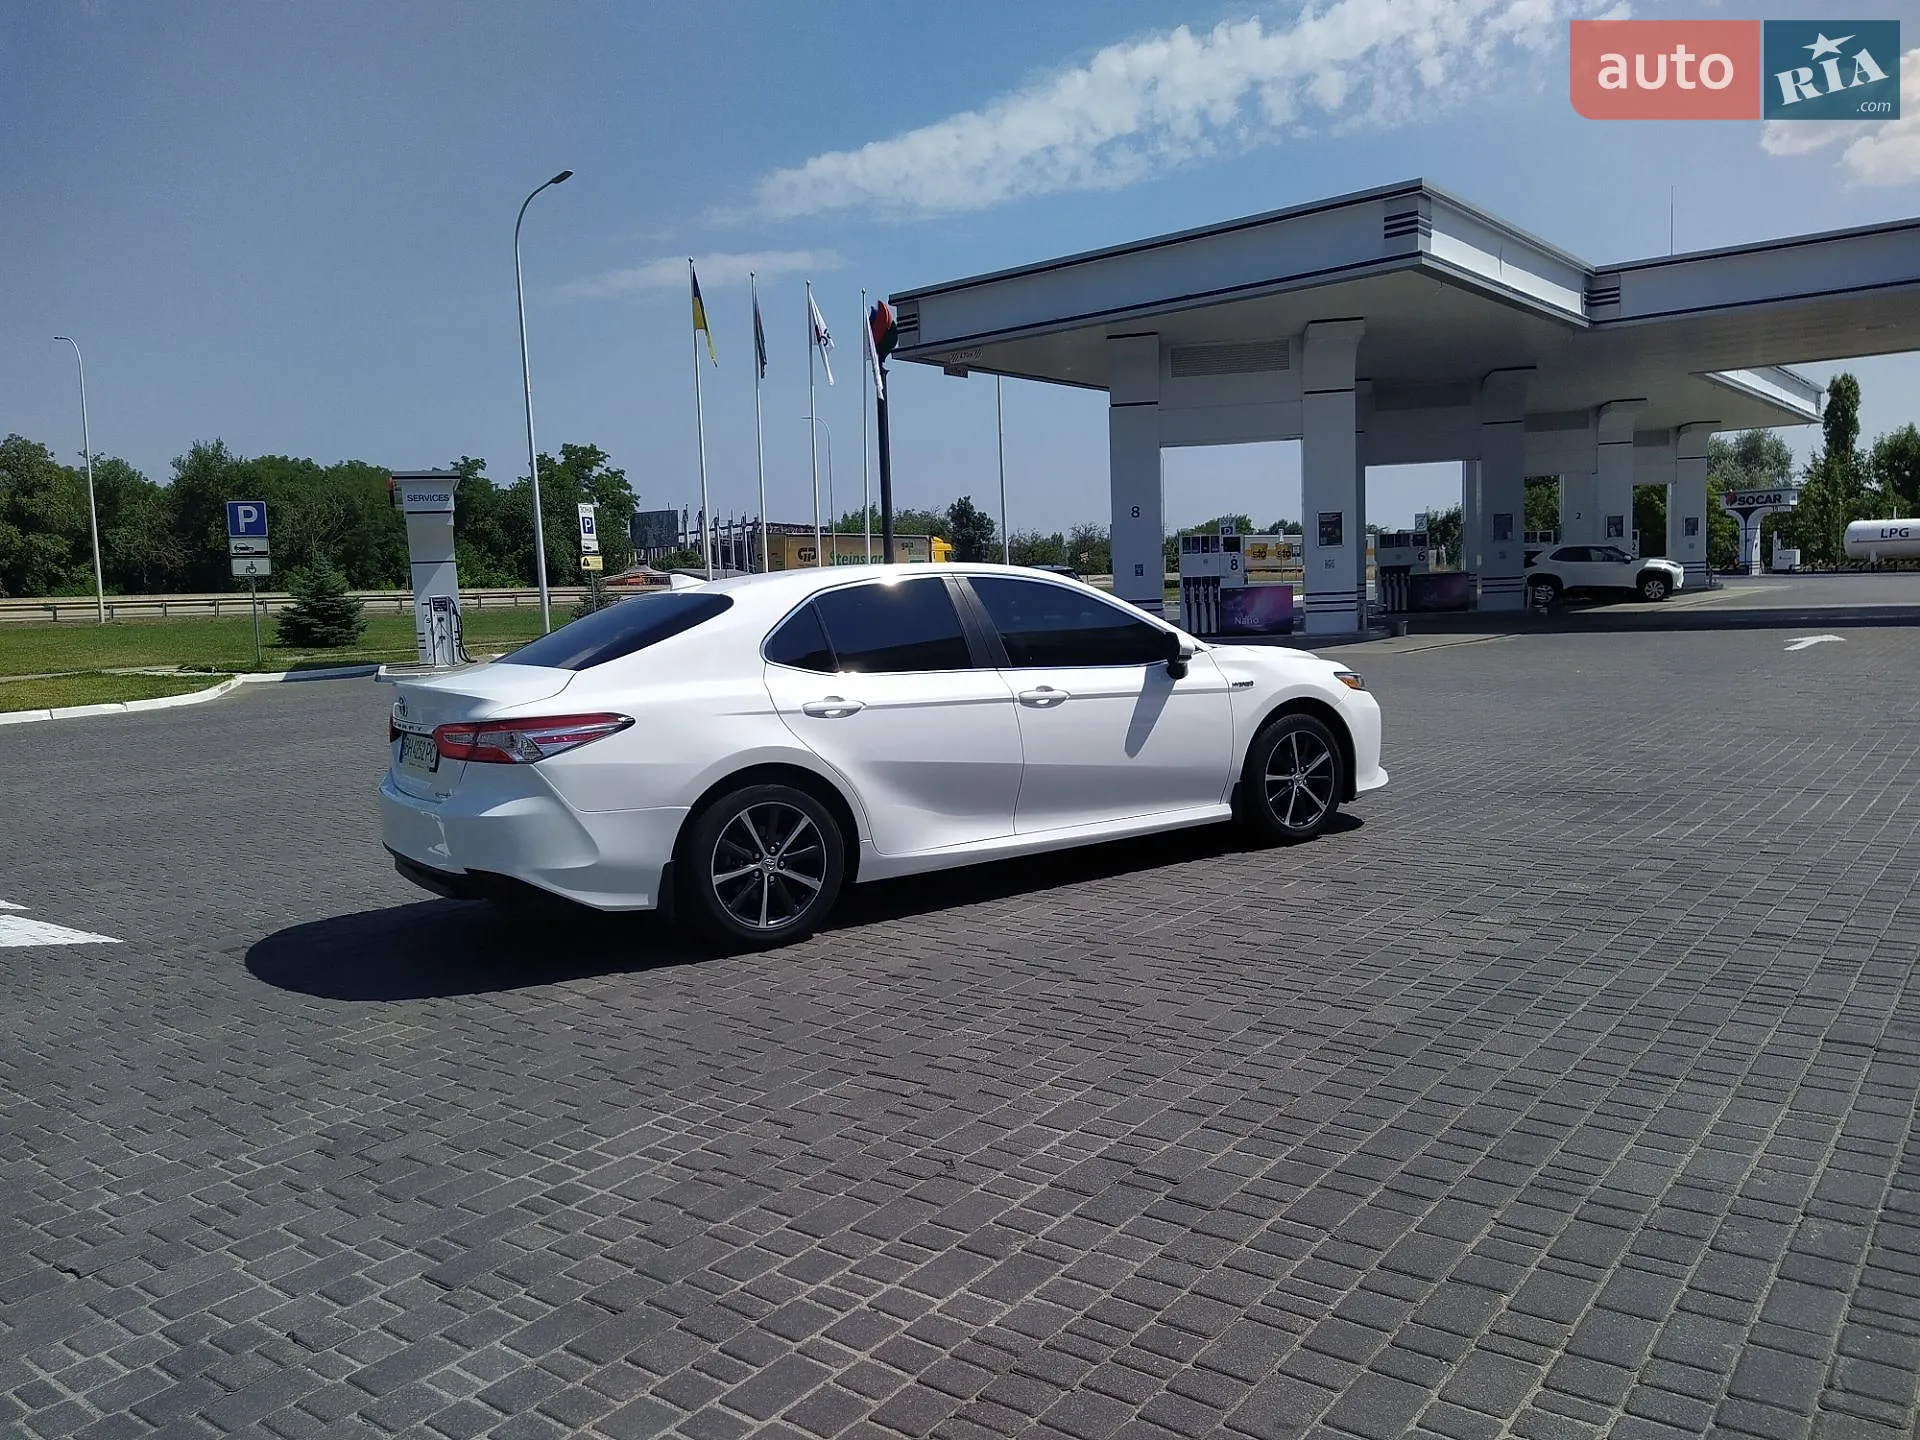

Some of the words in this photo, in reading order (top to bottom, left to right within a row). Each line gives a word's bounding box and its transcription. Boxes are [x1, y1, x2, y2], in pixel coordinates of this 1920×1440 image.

[406, 493, 450, 502] SERVICES
[1738, 493, 1782, 506] SOCAR
[1130, 505, 1141, 518] 8
[1575, 512, 1582, 520] 2
[237, 505, 258, 533] P
[584, 518, 592, 533] P
[1880, 527, 1910, 539] LPG
[1418, 551, 1426, 561] 6
[1230, 558, 1239, 571] 8
